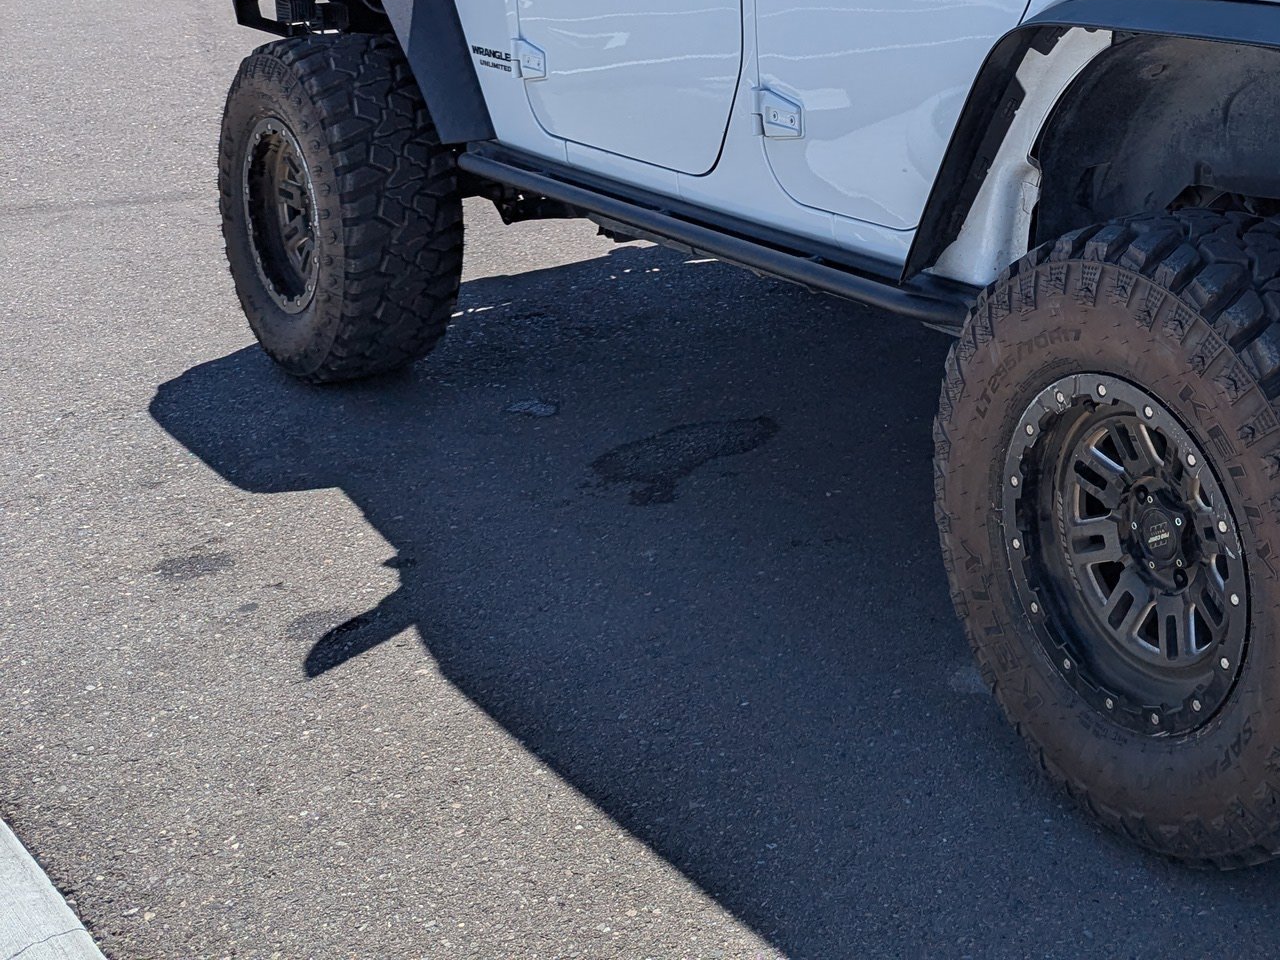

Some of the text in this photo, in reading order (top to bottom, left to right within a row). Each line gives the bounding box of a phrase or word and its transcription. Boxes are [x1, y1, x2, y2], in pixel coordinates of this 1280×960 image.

[471, 44, 512, 62] WRANGLE
[480, 59, 512, 72] UNLIMITED
[1178, 383, 1279, 582] KELLY
[960, 539, 1044, 715] KELLY
